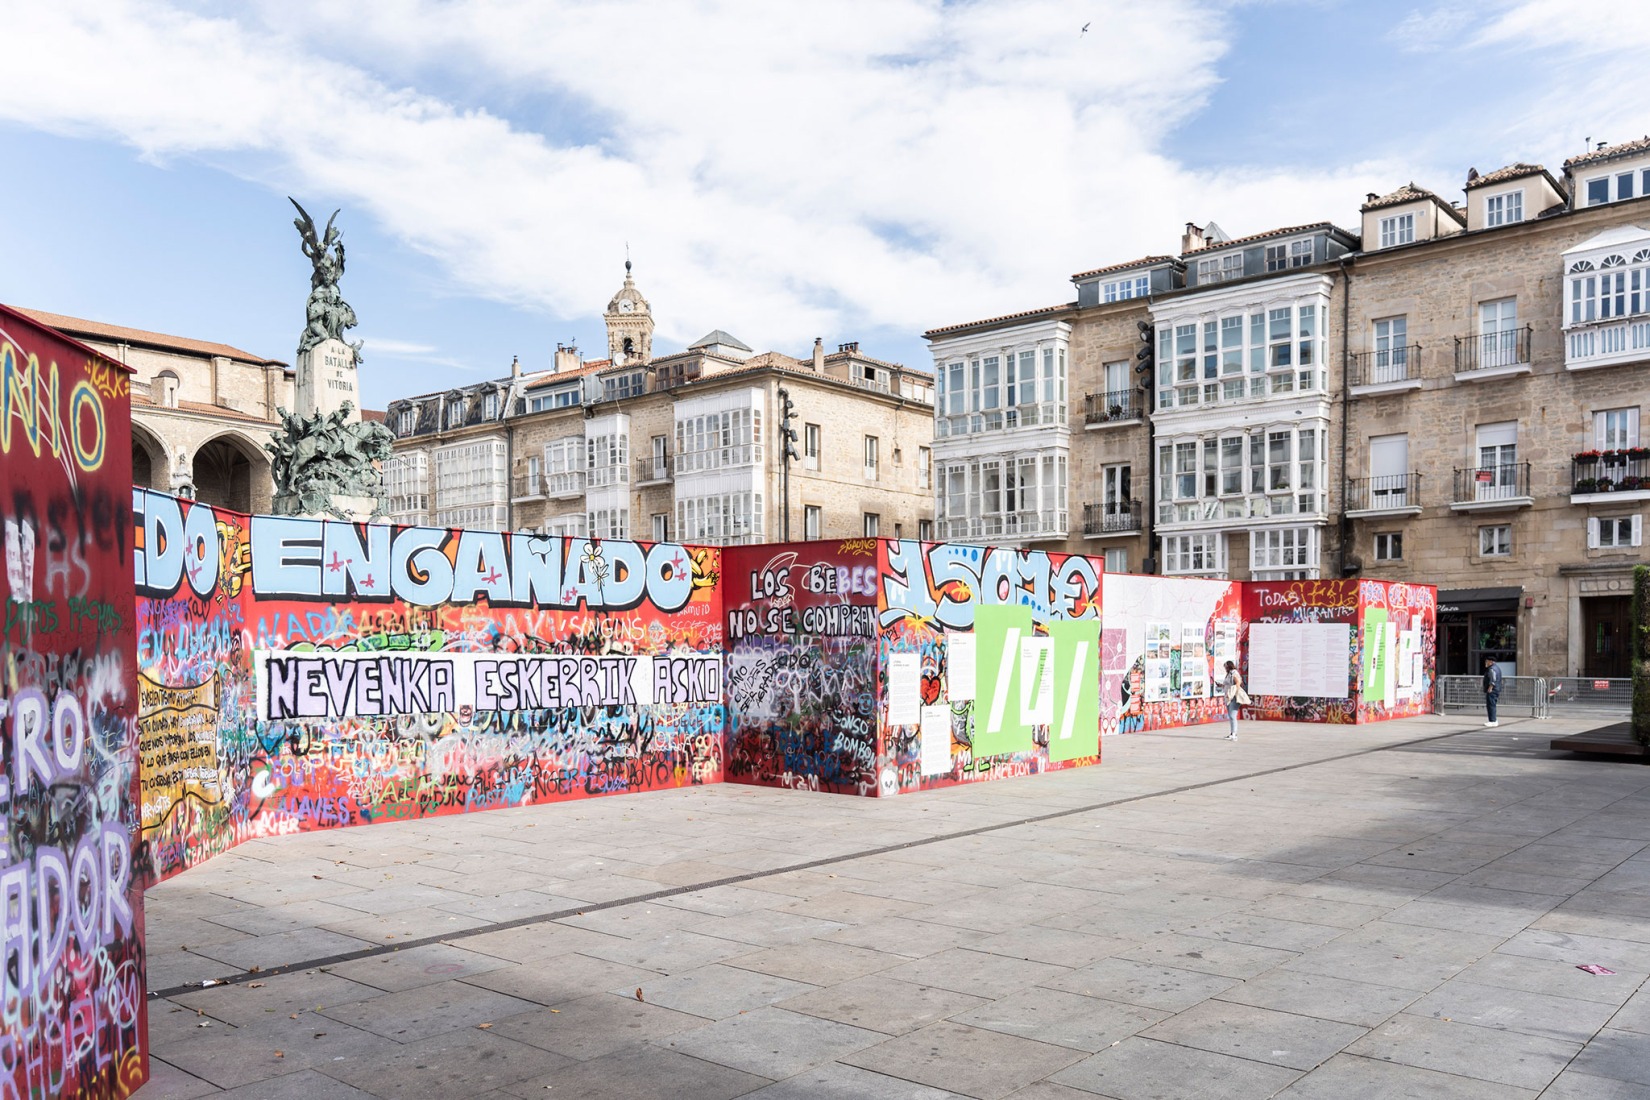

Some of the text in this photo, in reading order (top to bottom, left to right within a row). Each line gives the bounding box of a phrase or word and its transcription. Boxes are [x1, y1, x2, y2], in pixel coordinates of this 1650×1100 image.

[324, 356, 353, 370] BATALLA
[338, 346, 346, 355] LA
[327, 379, 353, 392] VITORIA
[133, 487, 218, 602] DO
[250, 514, 693, 613] ENGAÑADO
[750, 564, 878, 601] LOS BEBES
[1254, 589, 1300, 607] TODAS
[728, 609, 758, 640] NO
[765, 605, 797, 636] SE
[802, 604, 879, 640] COMPRAN
[265, 655, 720, 720] NEVENKA ESKERRIK ASKO
[0, 687, 86, 798] RO
